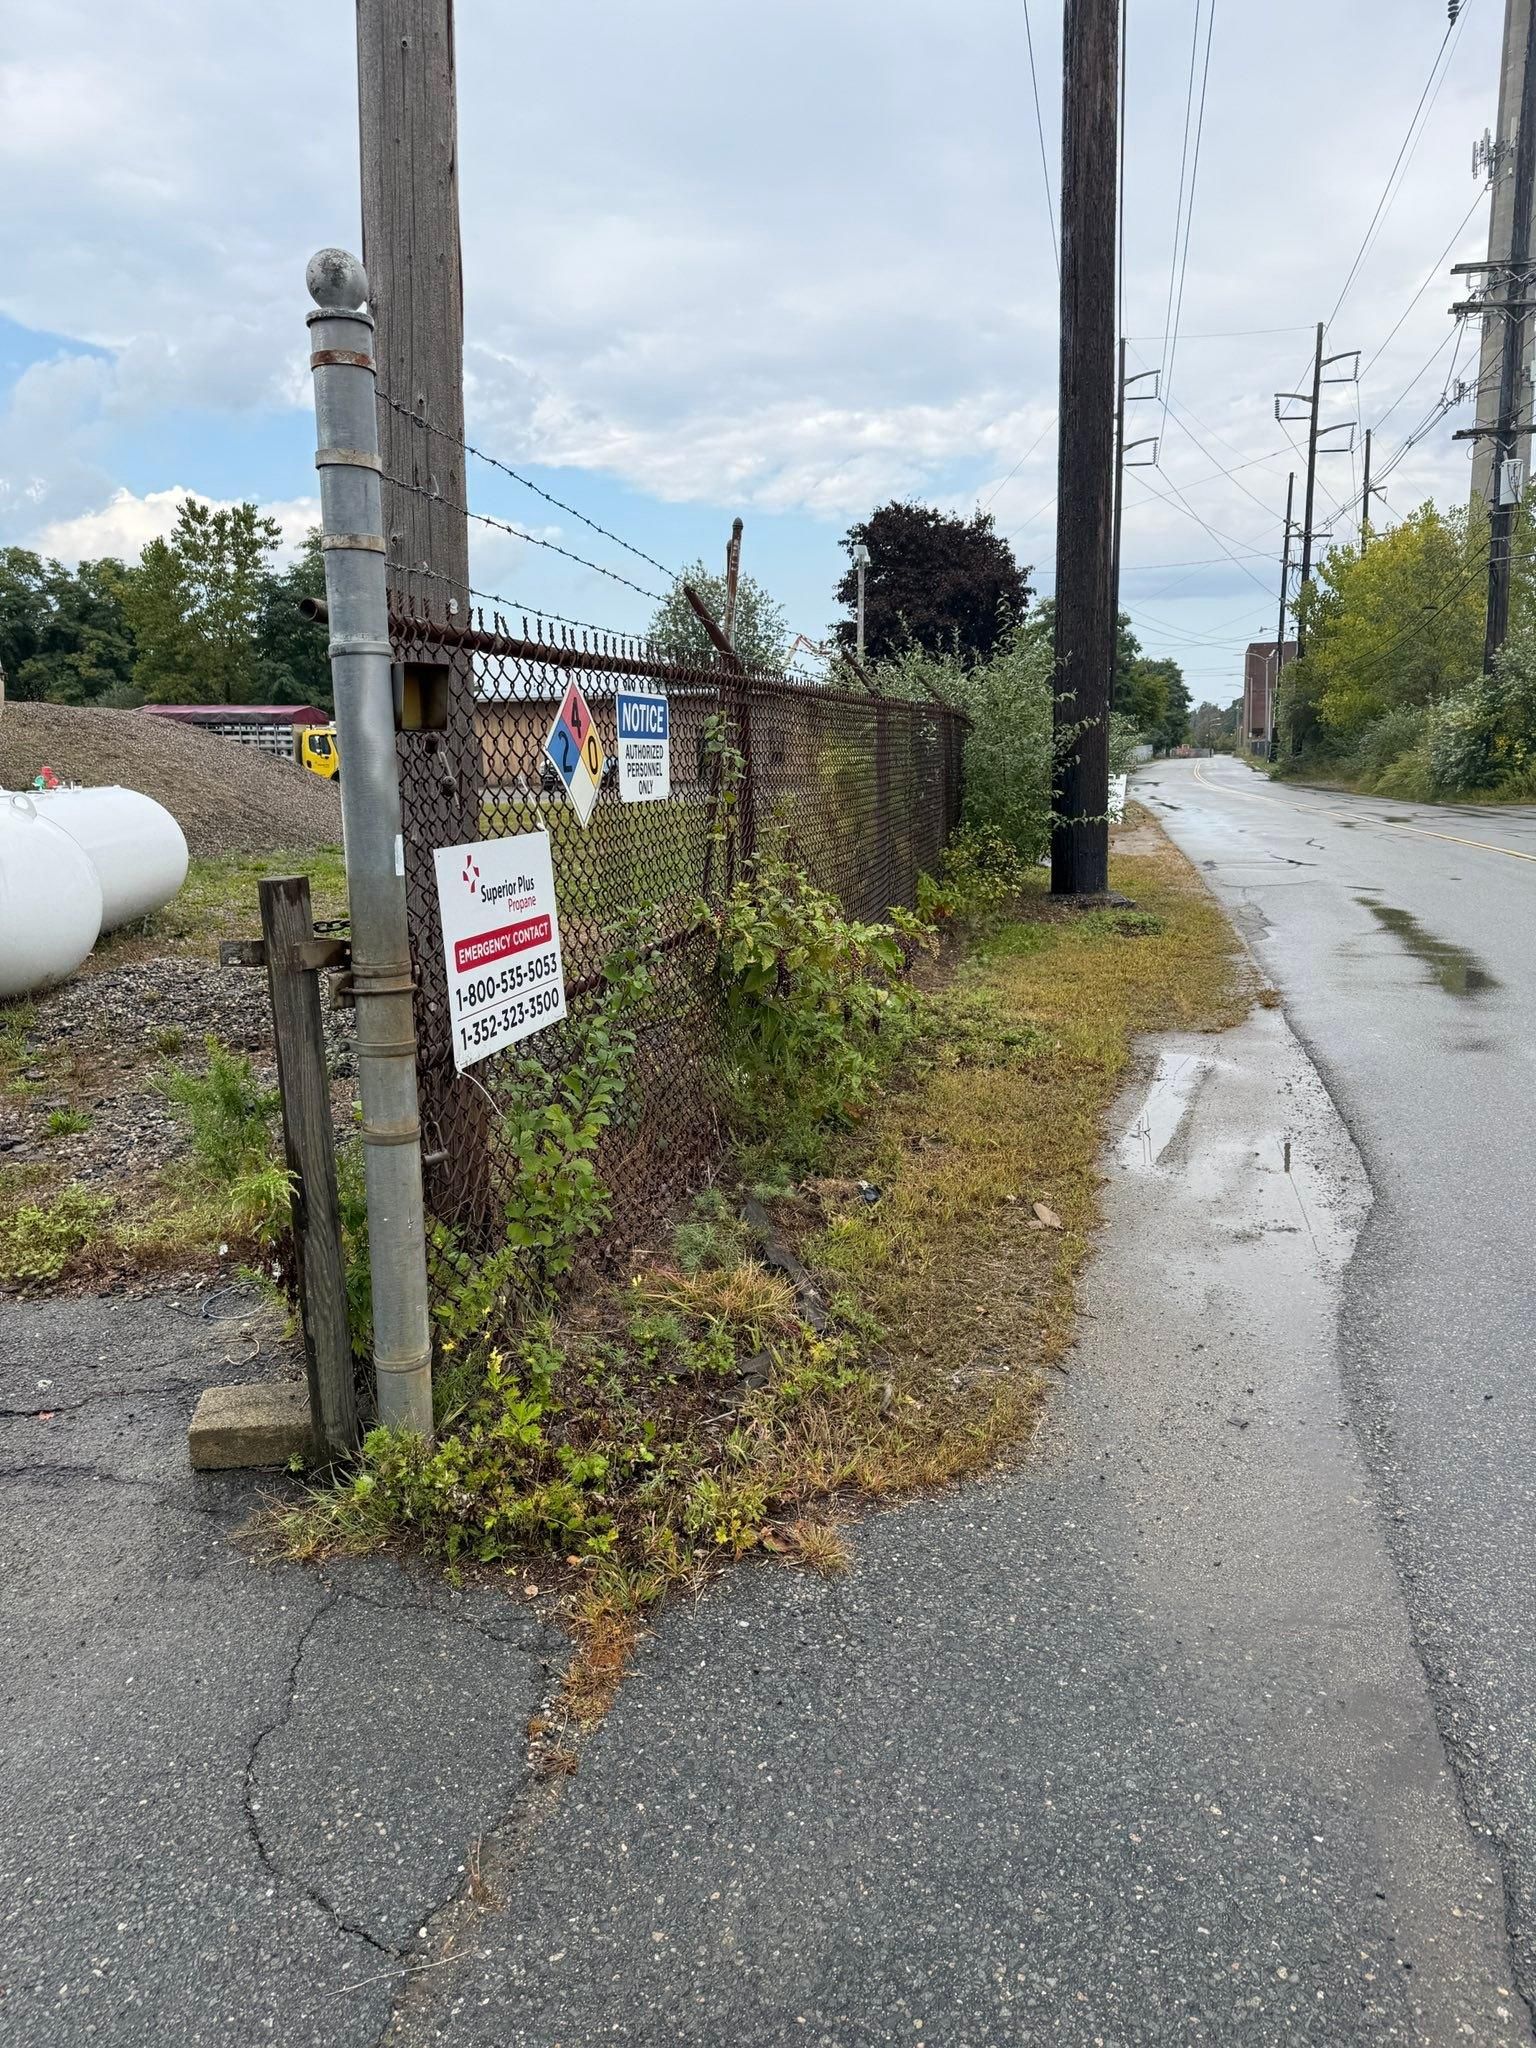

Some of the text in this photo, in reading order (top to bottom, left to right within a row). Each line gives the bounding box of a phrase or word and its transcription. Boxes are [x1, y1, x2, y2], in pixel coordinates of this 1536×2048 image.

[571, 697, 581, 738] 4
[622, 702, 664, 733] NOTICE
[558, 730, 573, 773] 2
[587, 735, 599, 775] 0
[625, 744, 664, 760] AUTHORIZED
[627, 762, 663, 778] PERSONNEL
[638, 780, 654, 795] ONLY
[480, 874, 535, 905] Superior Plus
[507, 895, 537, 913] Propane
[458, 922, 549, 965] EMERGENCY CONTACT
[455, 952, 558, 1012] 1-800-535-5053
[460, 987, 560, 1051] 1-352-323-3500
